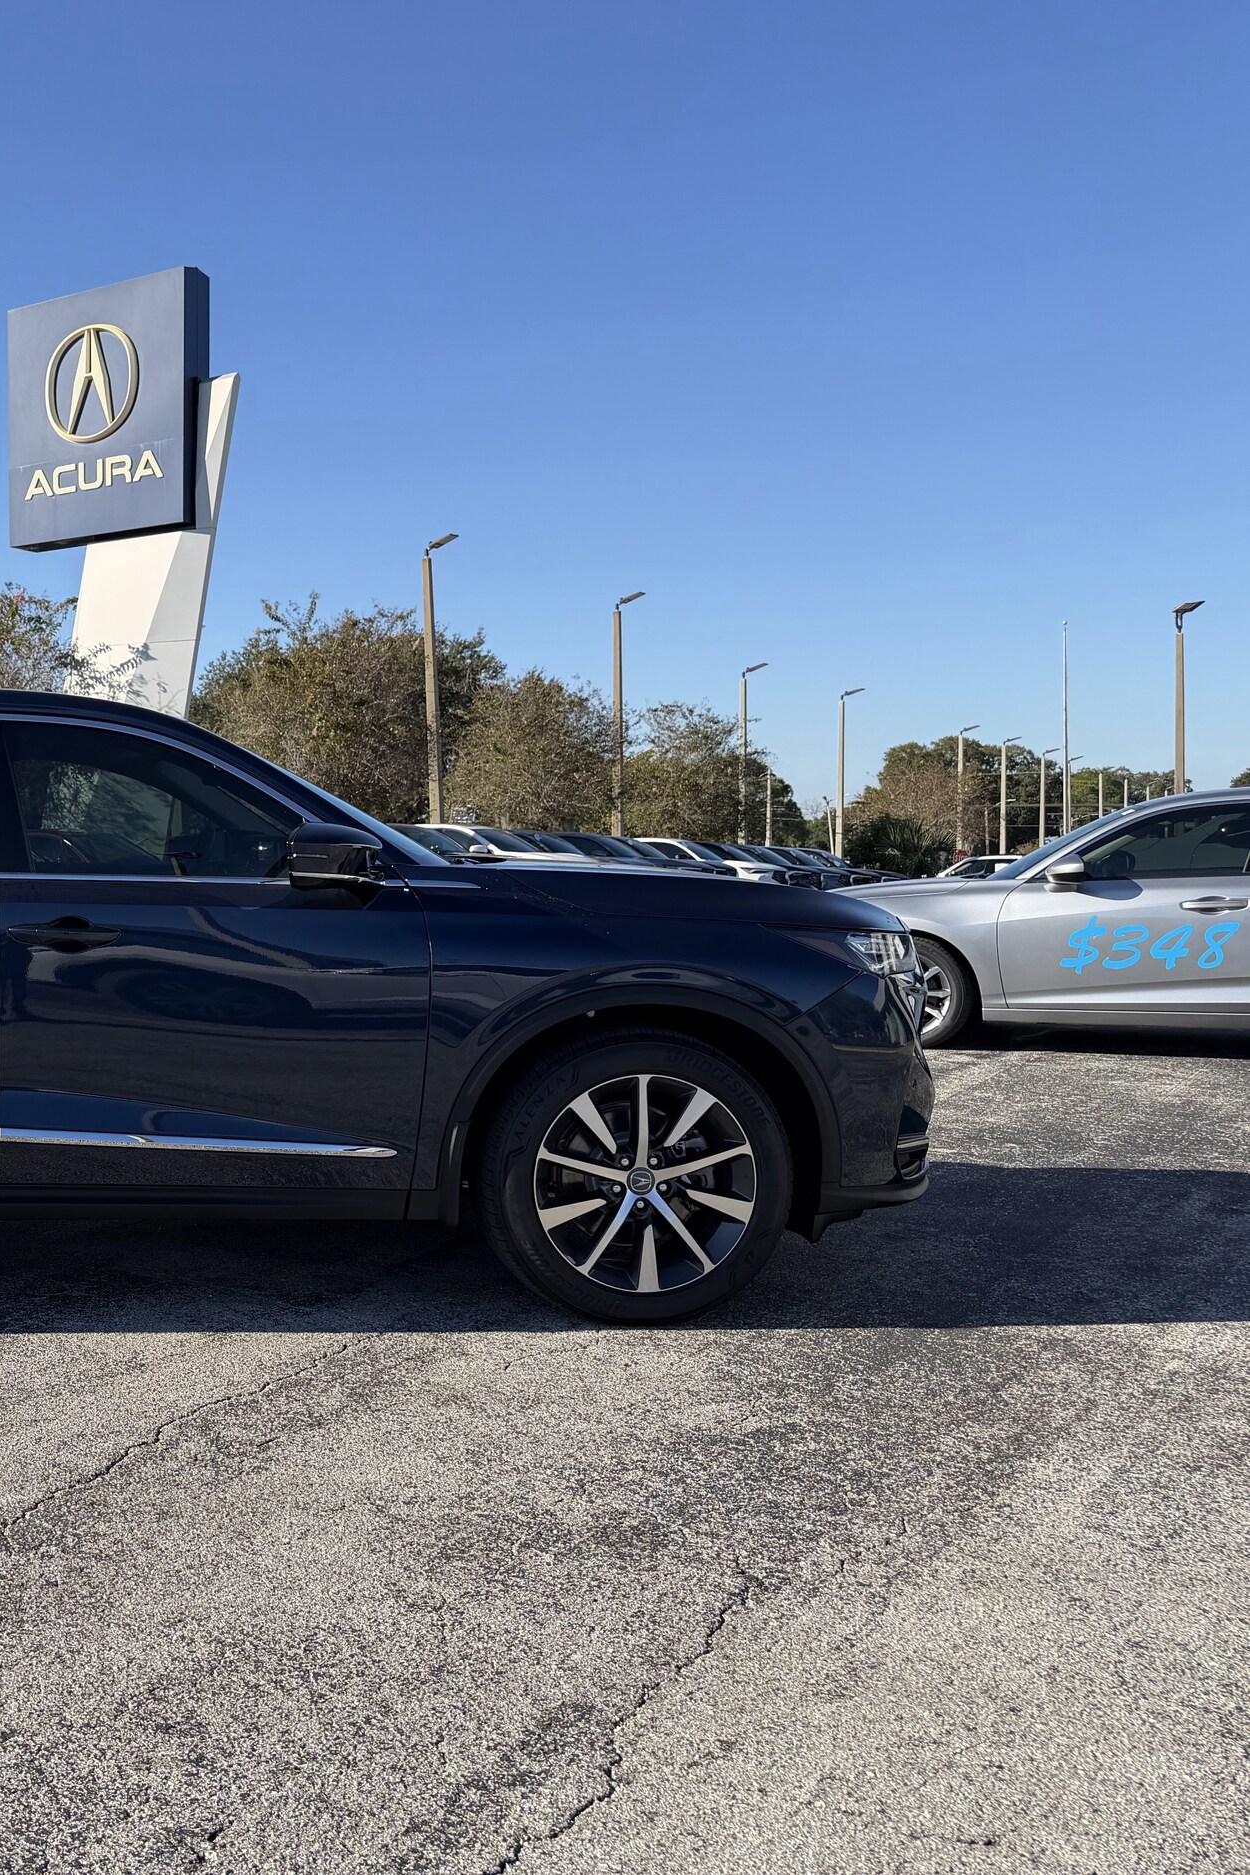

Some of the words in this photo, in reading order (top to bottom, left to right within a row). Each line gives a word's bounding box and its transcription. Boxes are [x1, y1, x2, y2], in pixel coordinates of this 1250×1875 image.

[25, 449, 164, 501] ACURA
[1059, 914, 1241, 975] $348
[514, 1076, 566, 1142] ALENZA
[663, 1048, 771, 1126] BRIDGESTONE
